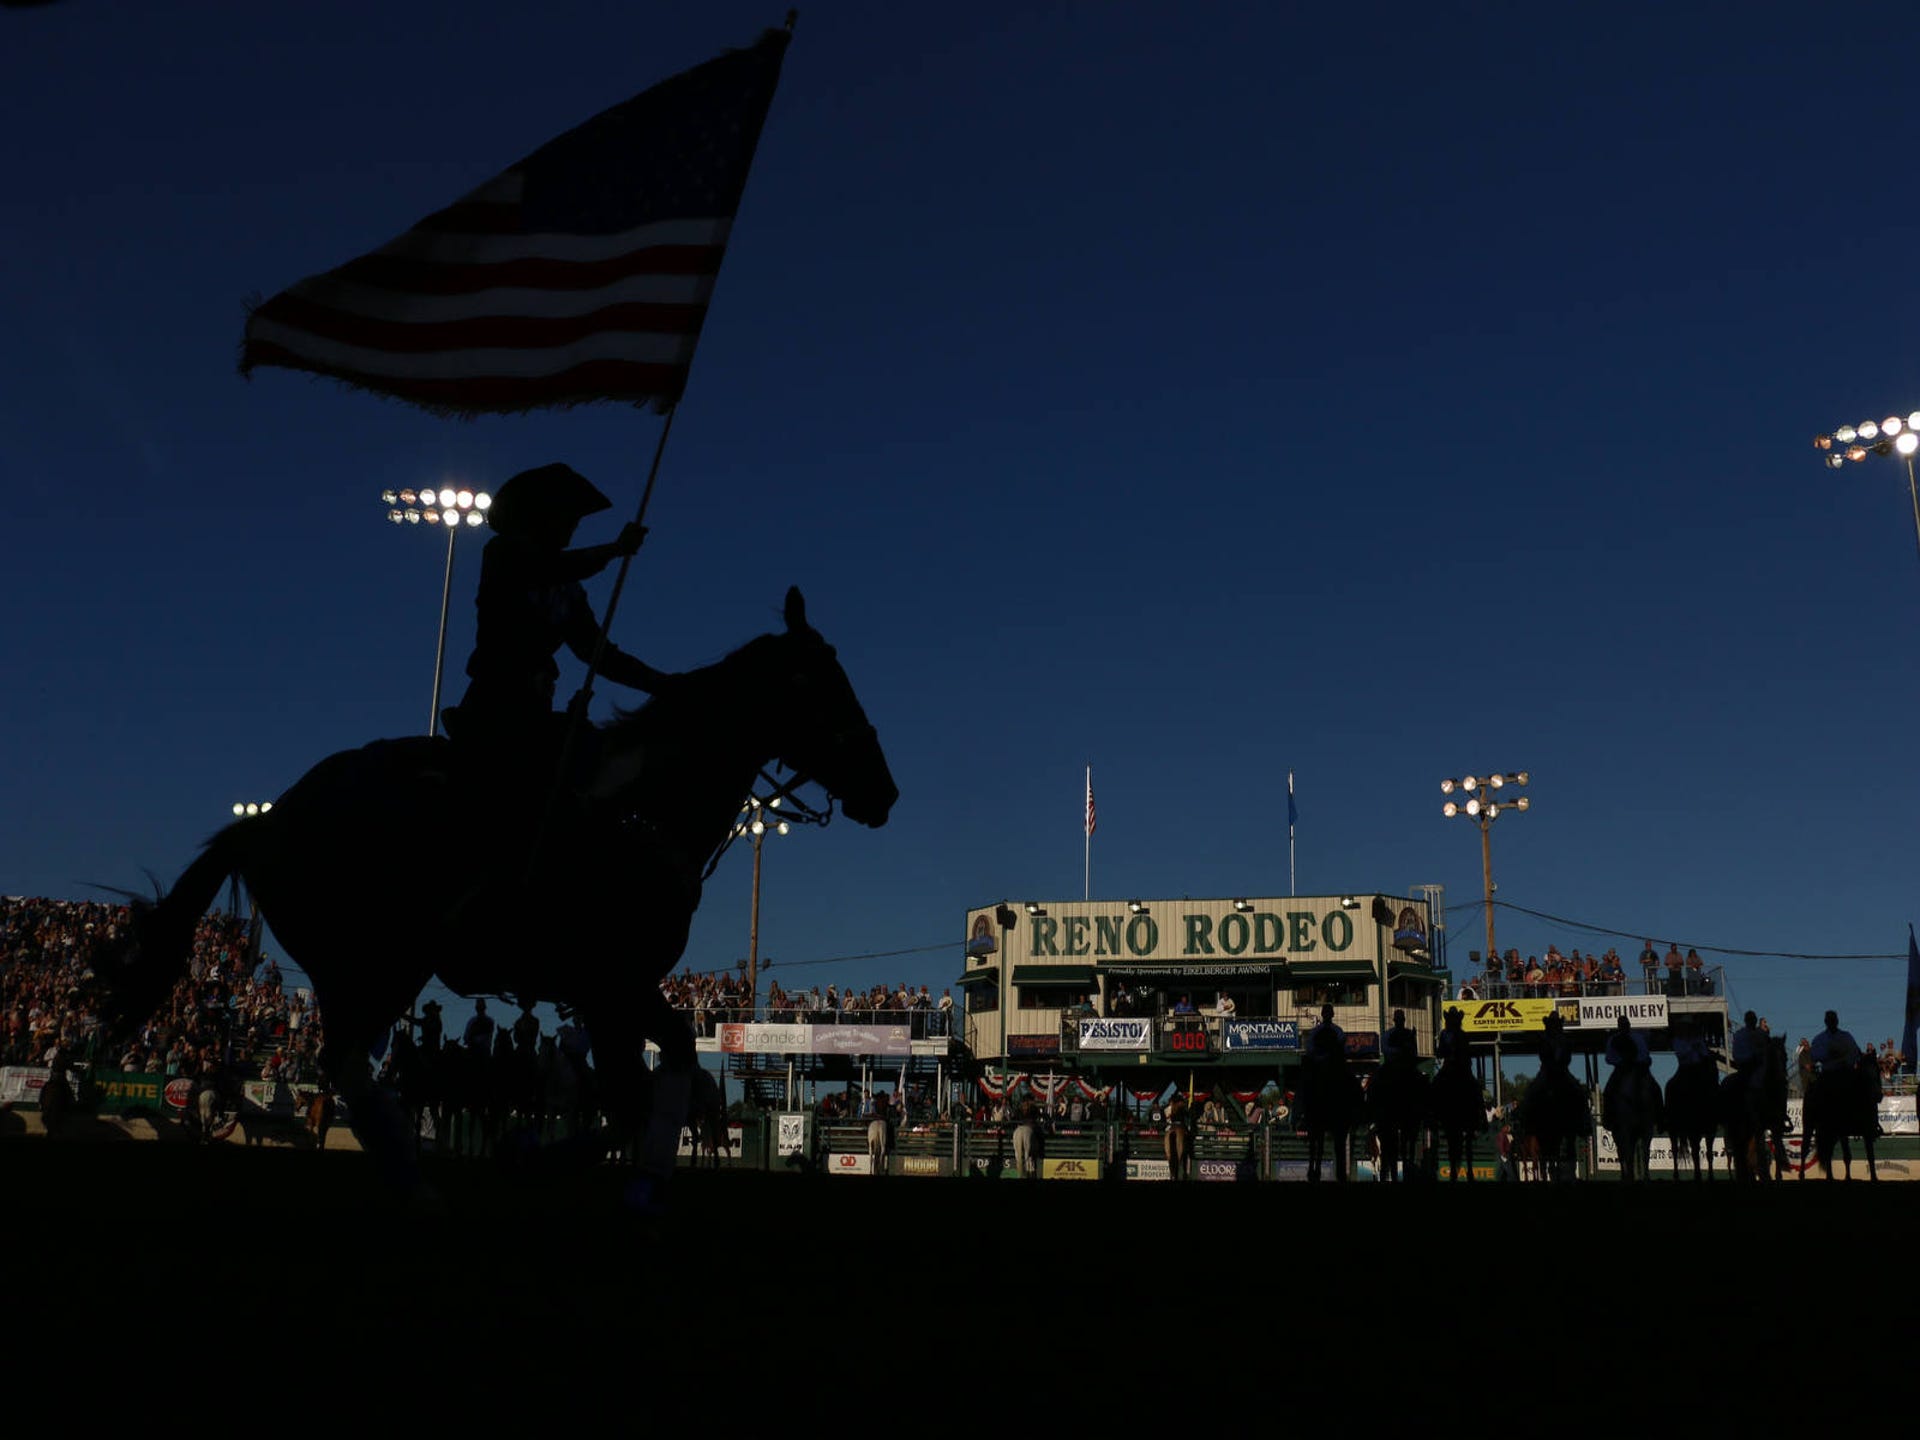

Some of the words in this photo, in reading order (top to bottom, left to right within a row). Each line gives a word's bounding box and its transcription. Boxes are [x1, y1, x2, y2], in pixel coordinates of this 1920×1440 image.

[1031, 915, 1158, 956] RENO
[1183, 910, 1353, 955] RODEO
[1238, 965, 1271, 974] AWNING
[1474, 1002, 1523, 1018] AK
[1582, 1003, 1664, 1019] MACHINERY
[746, 1025, 806, 1045] branded
[1228, 1023, 1294, 1034] MONTANA
[1055, 1161, 1086, 1172] AK
